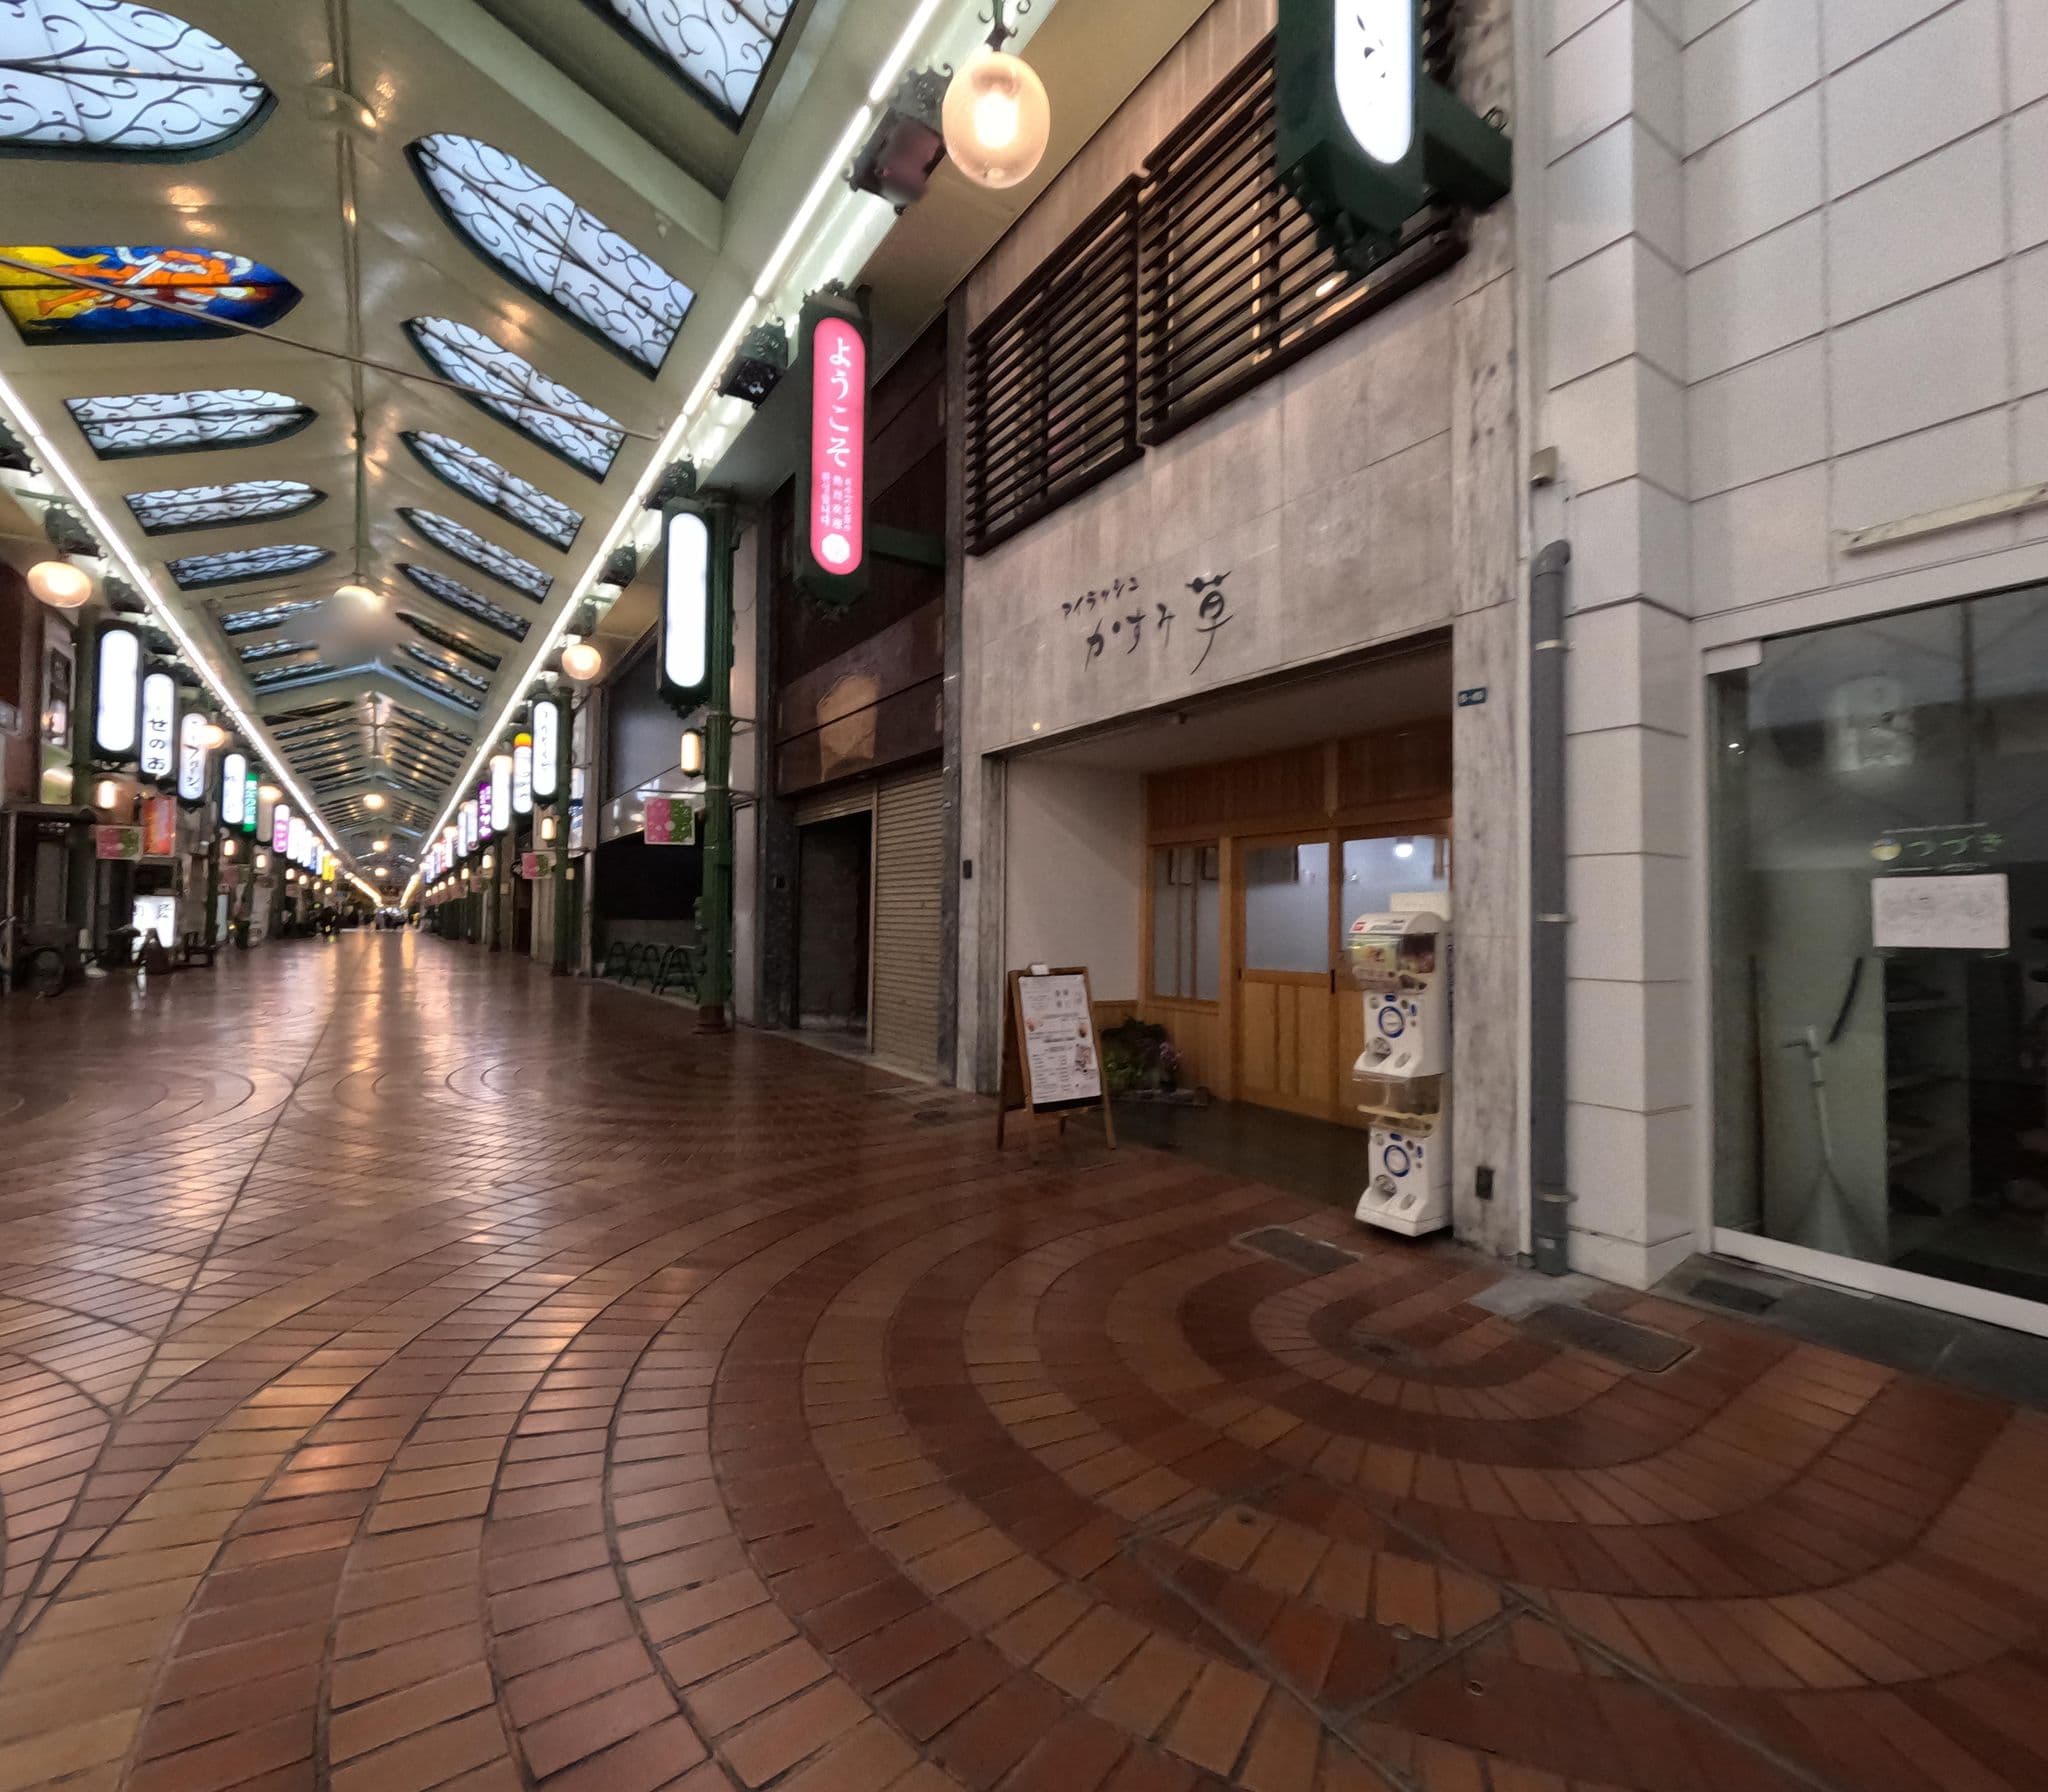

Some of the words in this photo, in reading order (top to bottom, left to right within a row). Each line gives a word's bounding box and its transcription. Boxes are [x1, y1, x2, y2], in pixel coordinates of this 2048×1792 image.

[826, 337, 851, 468] ようこそ
[1084, 570, 1233, 675] かすみ草
